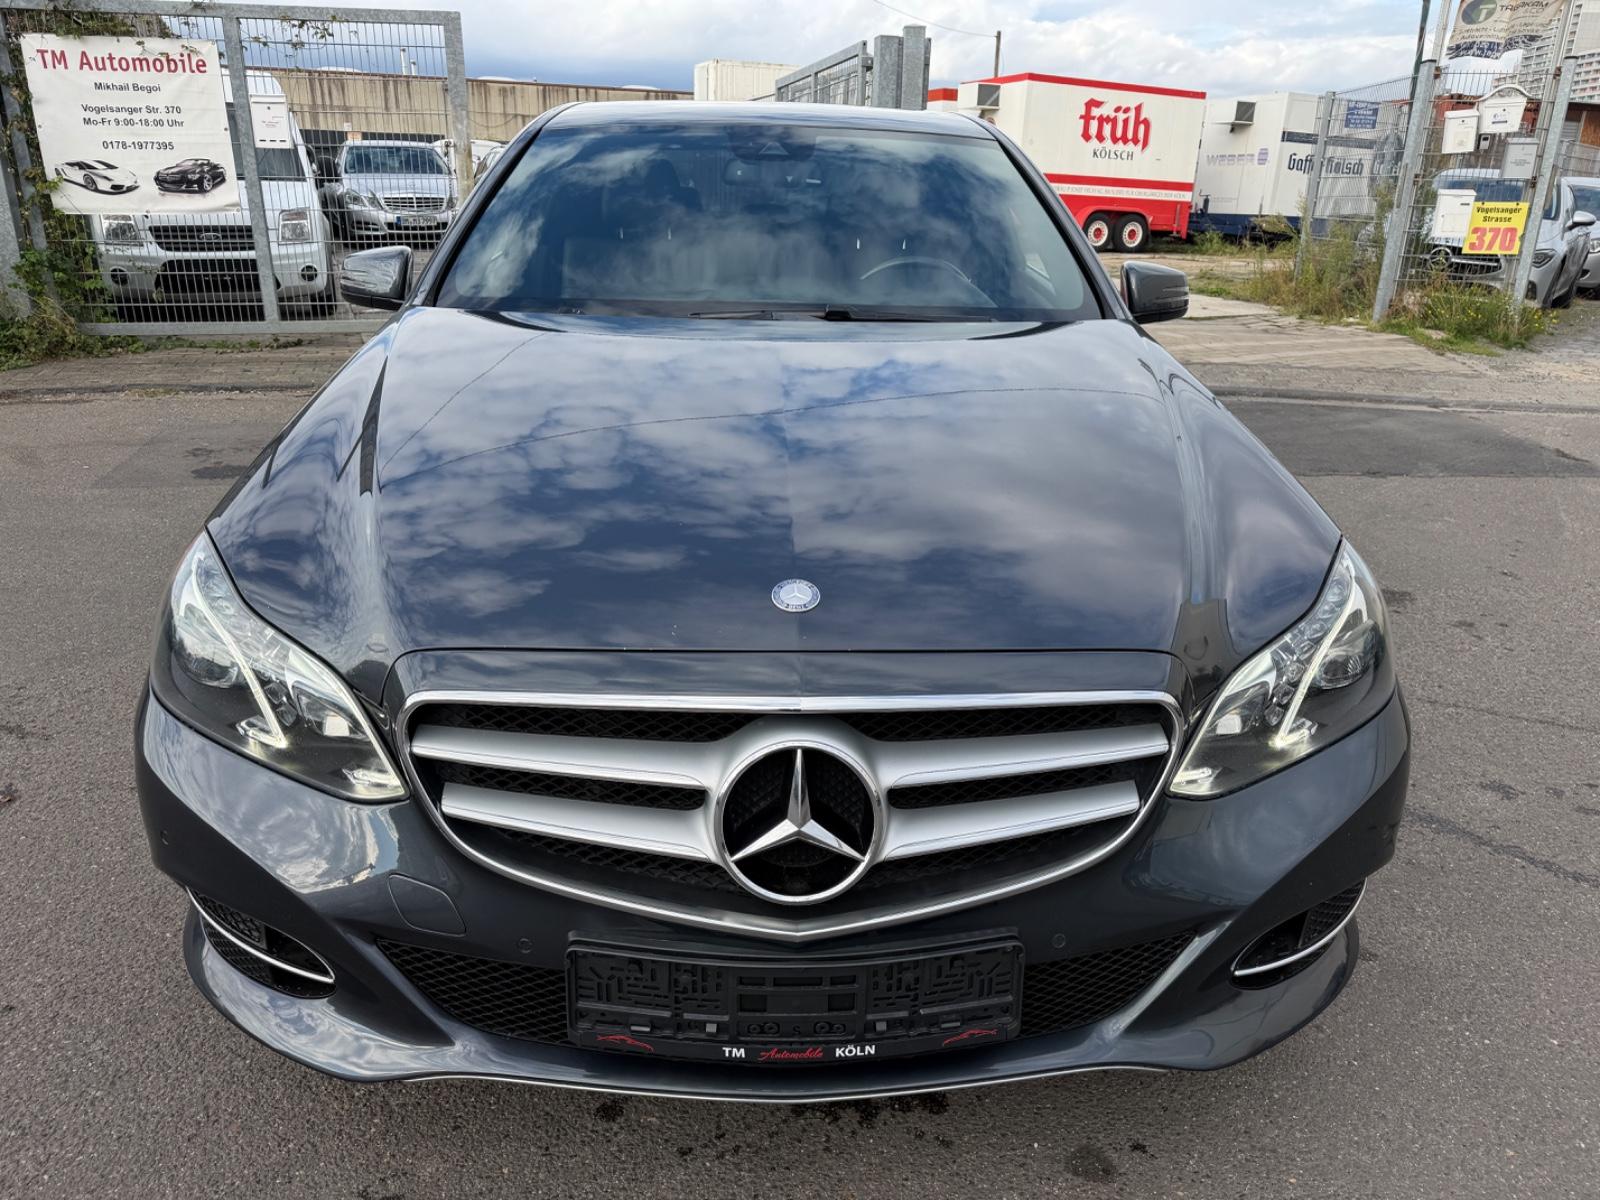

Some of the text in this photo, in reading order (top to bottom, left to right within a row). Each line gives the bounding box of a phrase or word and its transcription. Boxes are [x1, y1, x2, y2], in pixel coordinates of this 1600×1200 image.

[36, 49, 207, 73] TM Automobile
[94, 82, 161, 93] Mikhail Begoi
[81, 104, 182, 115] Vogelsanger Str. 370
[83, 117, 184, 128] Mo-Fr 9:00-18:00 Uhr
[102, 140, 175, 150] 0178-1977395
[1092, 147, 1134, 161] KÖLSCH
[1476, 206, 1522, 215] Vogelsanger
[1482, 215, 1512, 223] Strasse
[1468, 227, 1518, 251] 370
[722, 1047, 745, 1058] TM
[835, 1045, 876, 1058] KÖLN
